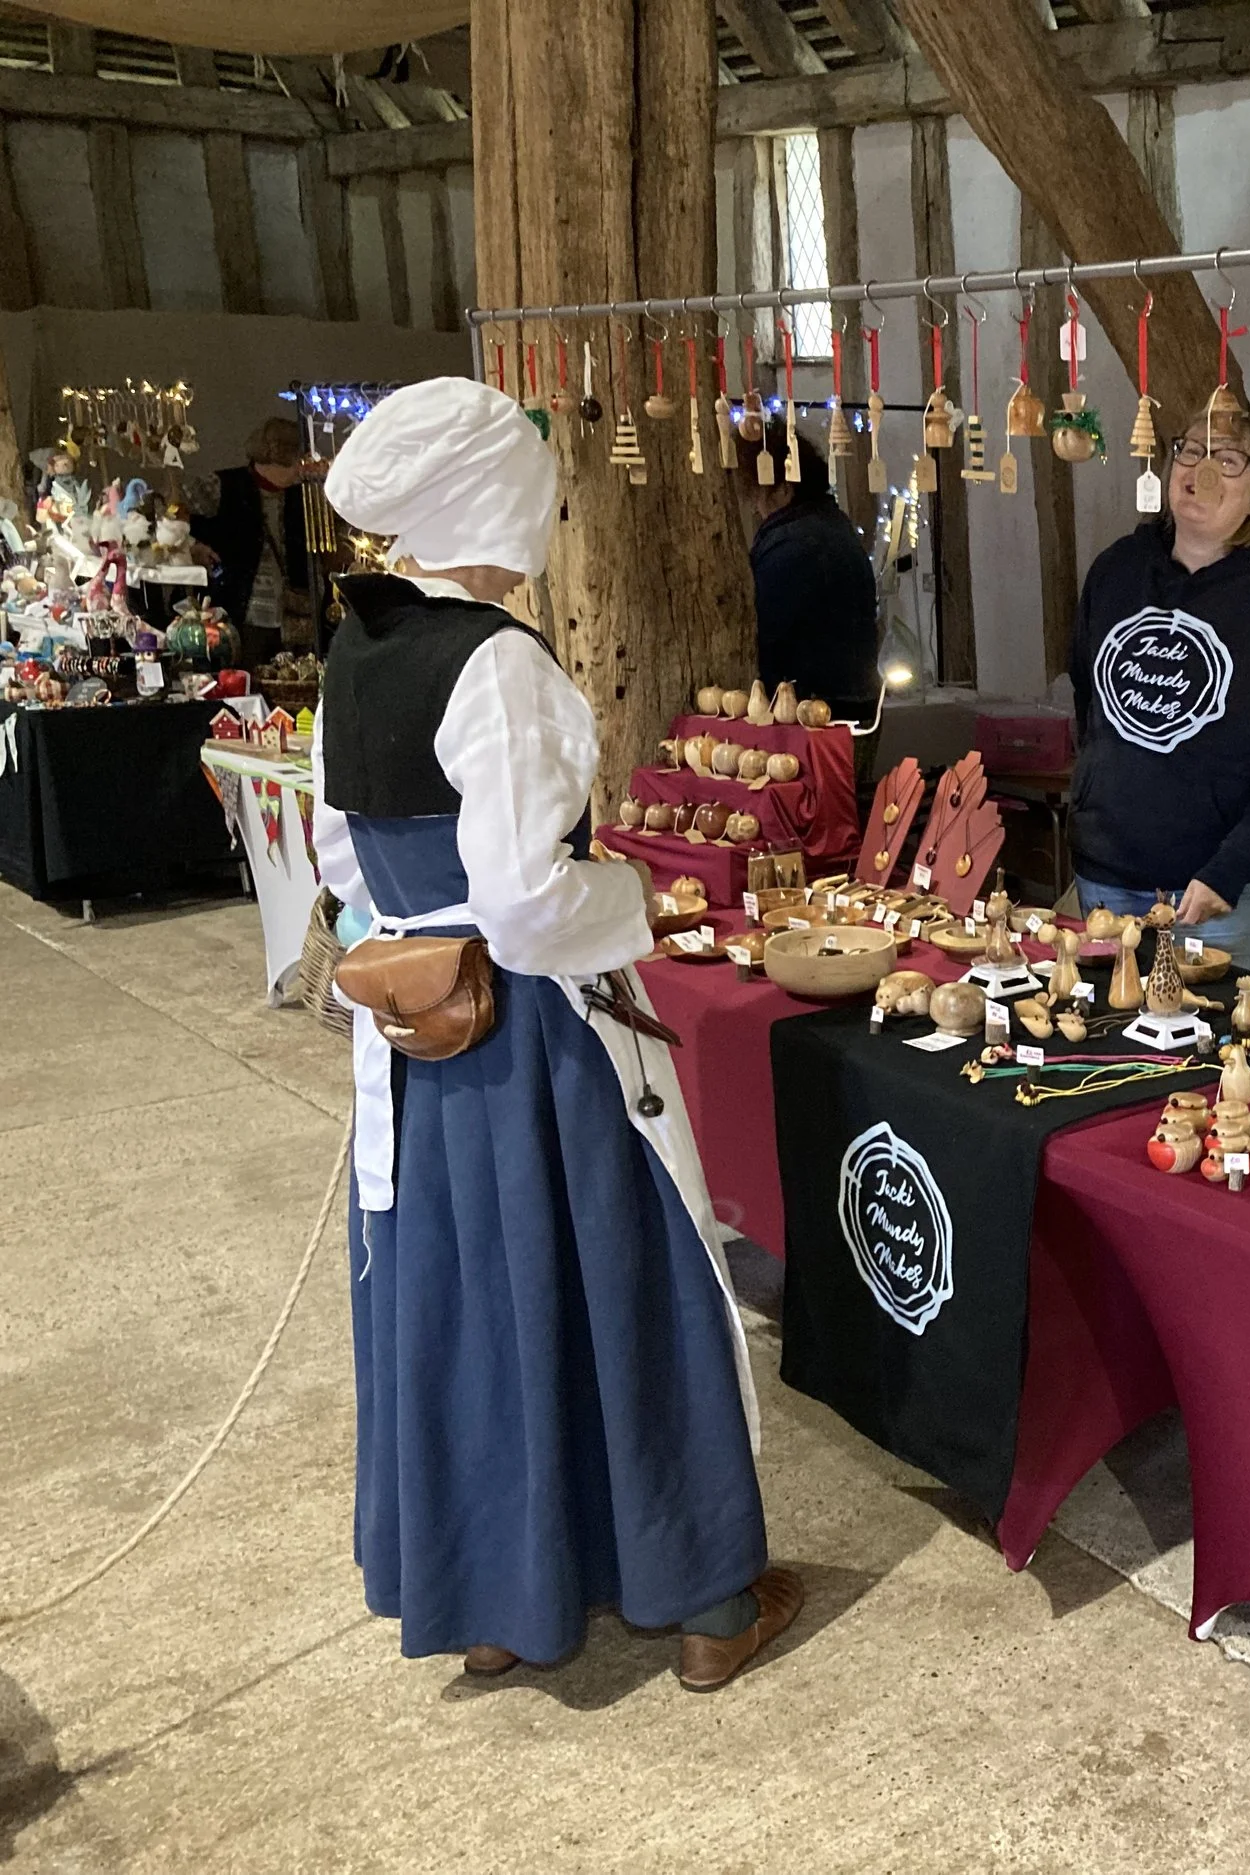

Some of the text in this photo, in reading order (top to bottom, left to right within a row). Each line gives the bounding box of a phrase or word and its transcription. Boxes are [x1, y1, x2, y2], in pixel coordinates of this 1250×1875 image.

[1131, 636, 1189, 661] Jacki
[1118, 660, 1191, 696] Mundy
[1120, 689, 1181, 720] Makes
[875, 1169, 916, 1207] Jacki
[866, 1201, 925, 1256] Mundy
[873, 1242, 923, 1290] Makes
